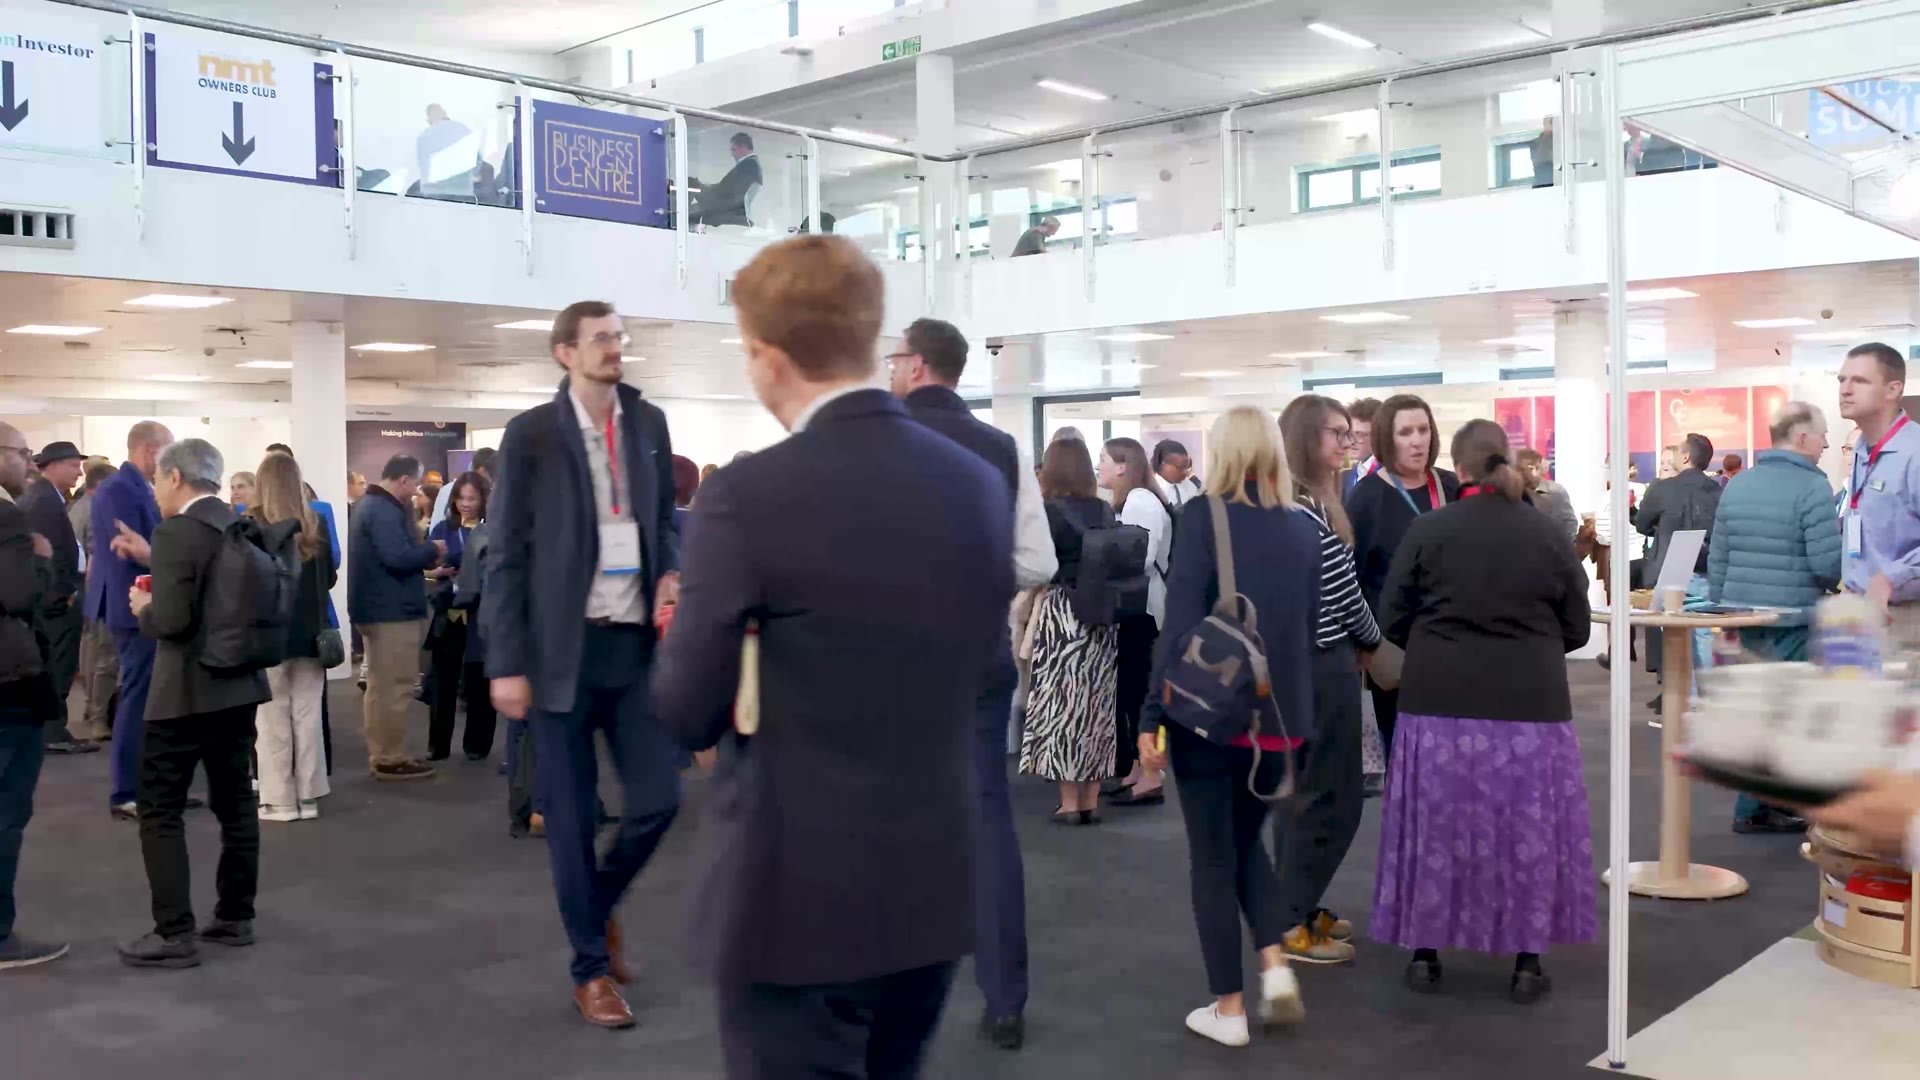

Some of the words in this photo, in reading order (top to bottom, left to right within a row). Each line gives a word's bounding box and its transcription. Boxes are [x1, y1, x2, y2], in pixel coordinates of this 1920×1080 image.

[0, 34, 94, 59] nInvestor
[198, 78, 249, 95] OWNERS
[252, 86, 277, 99] CLUB
[553, 131, 634, 160] BUSINESS
[553, 144, 633, 175] DESIGN
[554, 165, 634, 195] CENTRE
[381, 430, 402, 438] Making
